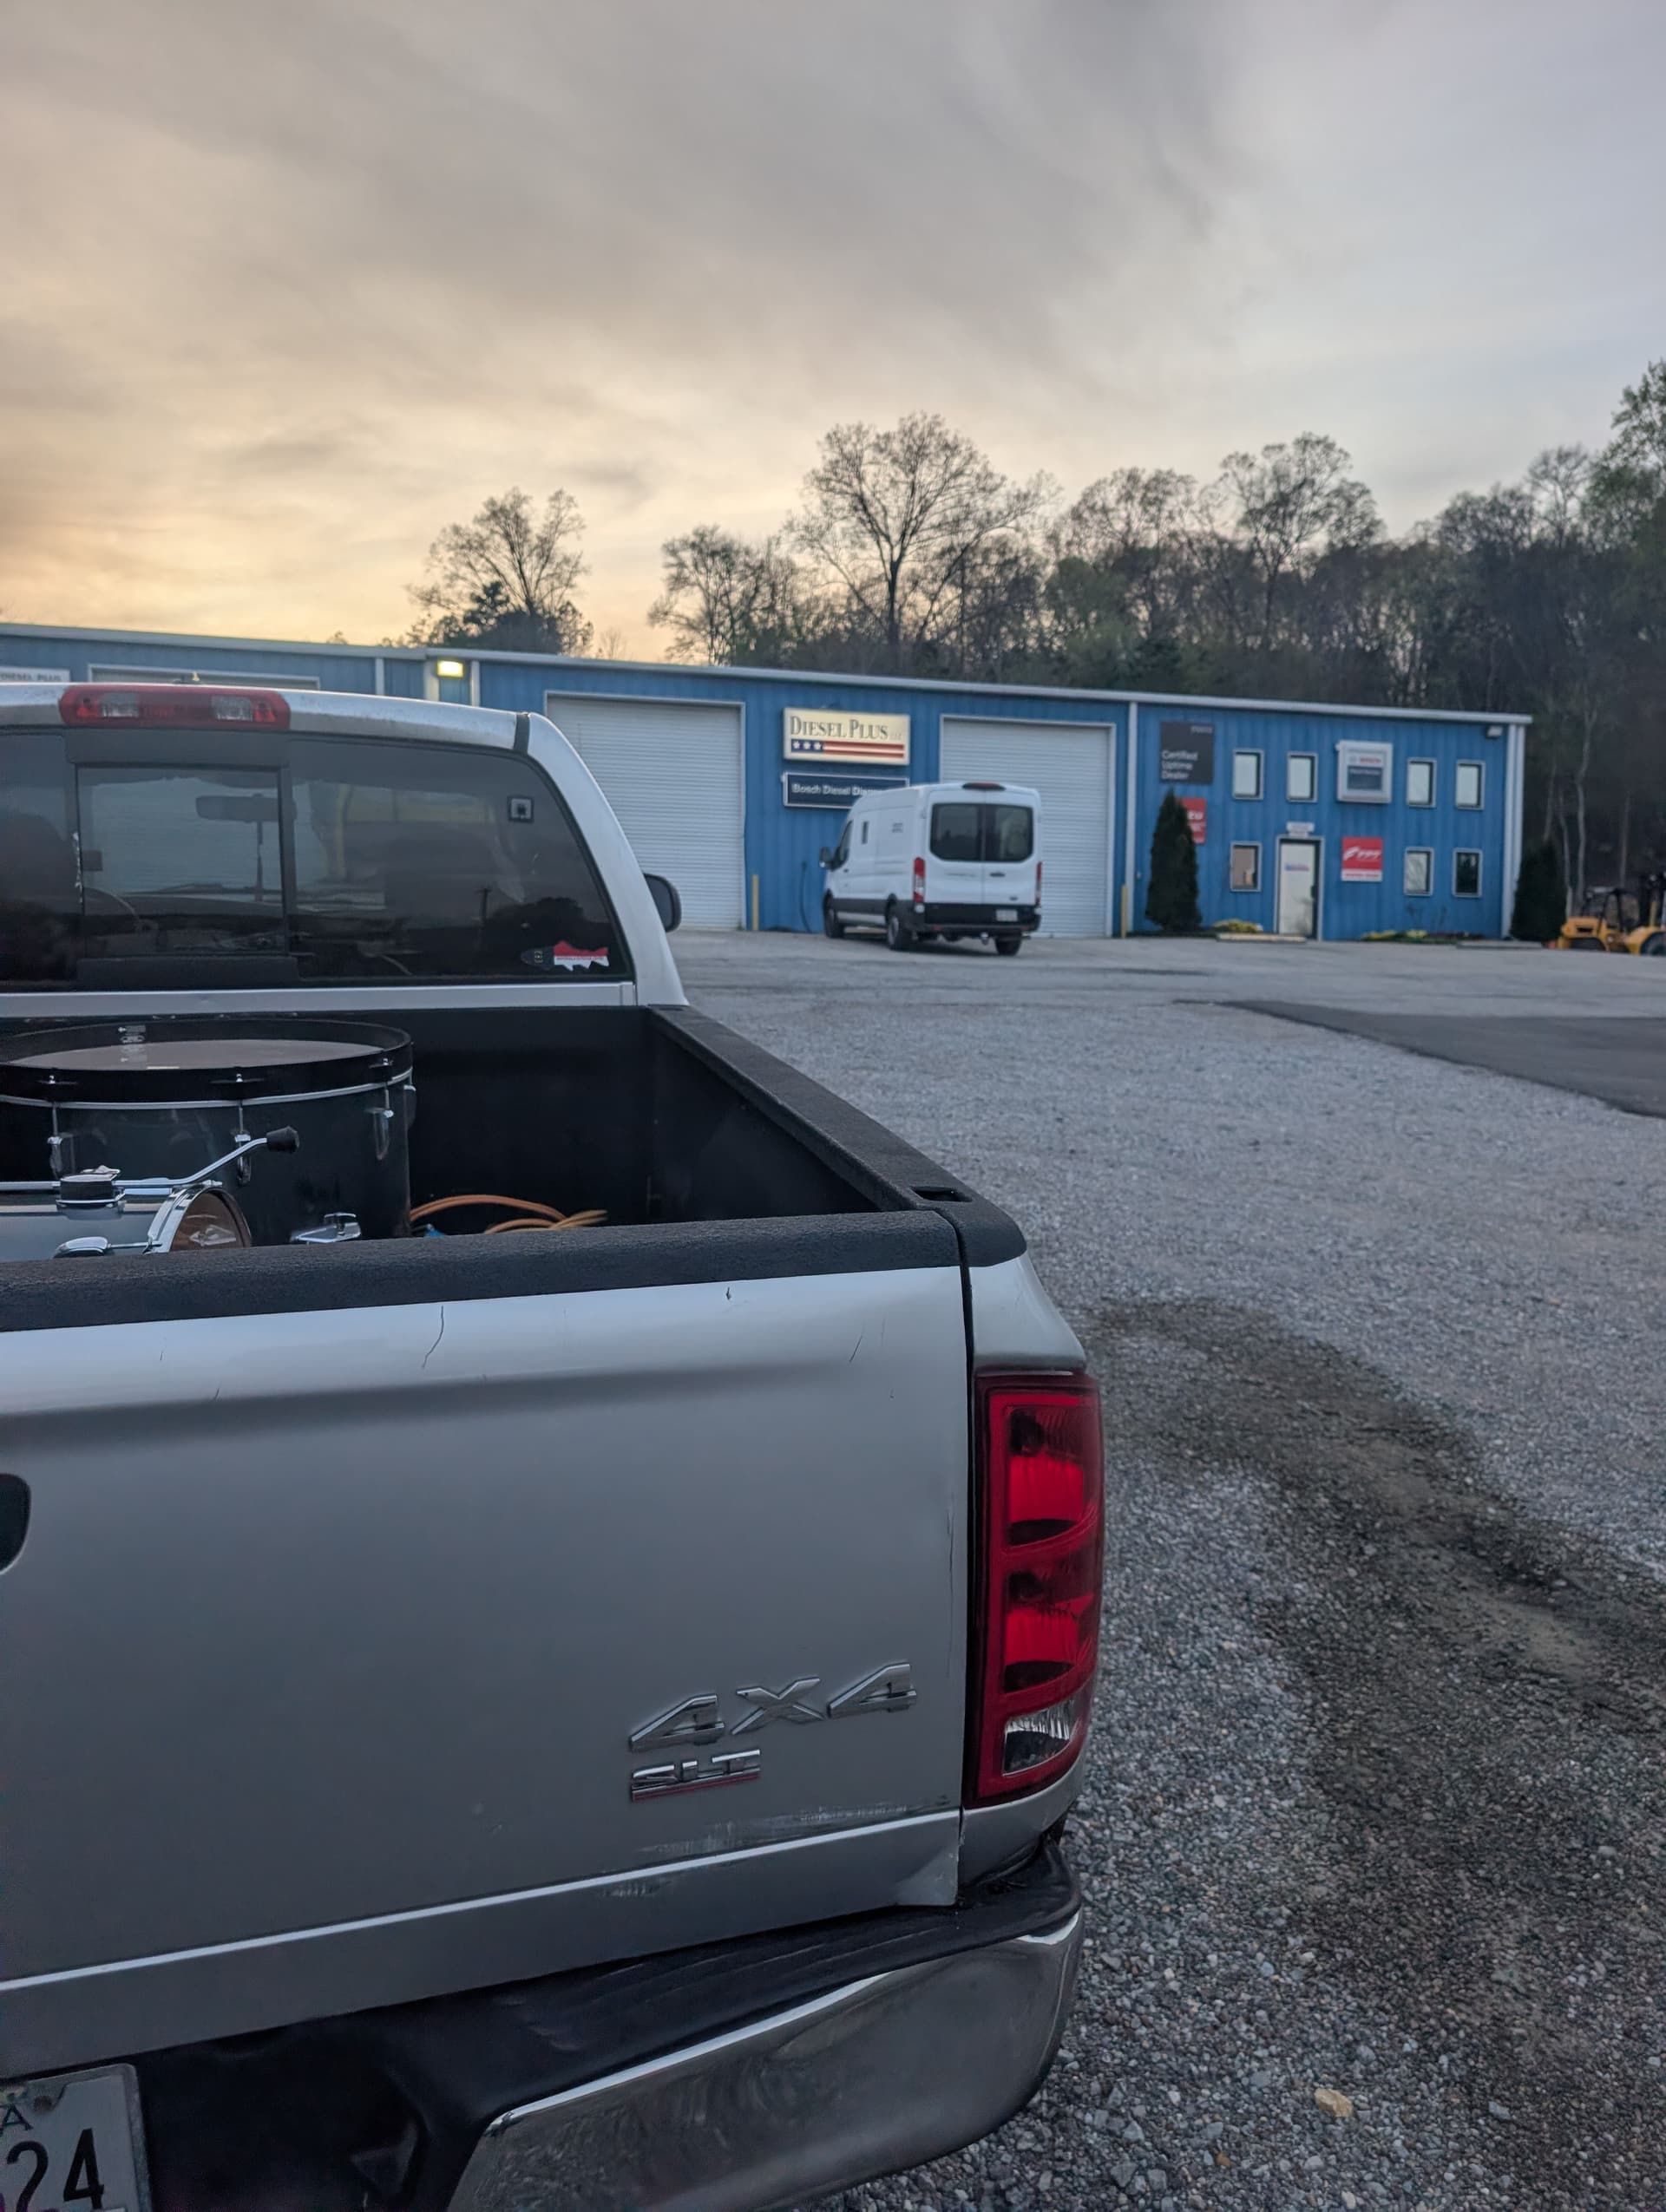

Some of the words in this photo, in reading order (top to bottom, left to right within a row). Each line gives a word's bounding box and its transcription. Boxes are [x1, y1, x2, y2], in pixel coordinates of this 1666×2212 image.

[790, 715, 847, 738] DIESEL
[848, 718, 889, 739] PLUS
[791, 783, 821, 795] Bosch
[822, 784, 850, 795] Diesel
[632, 1748, 761, 1796] SLT
